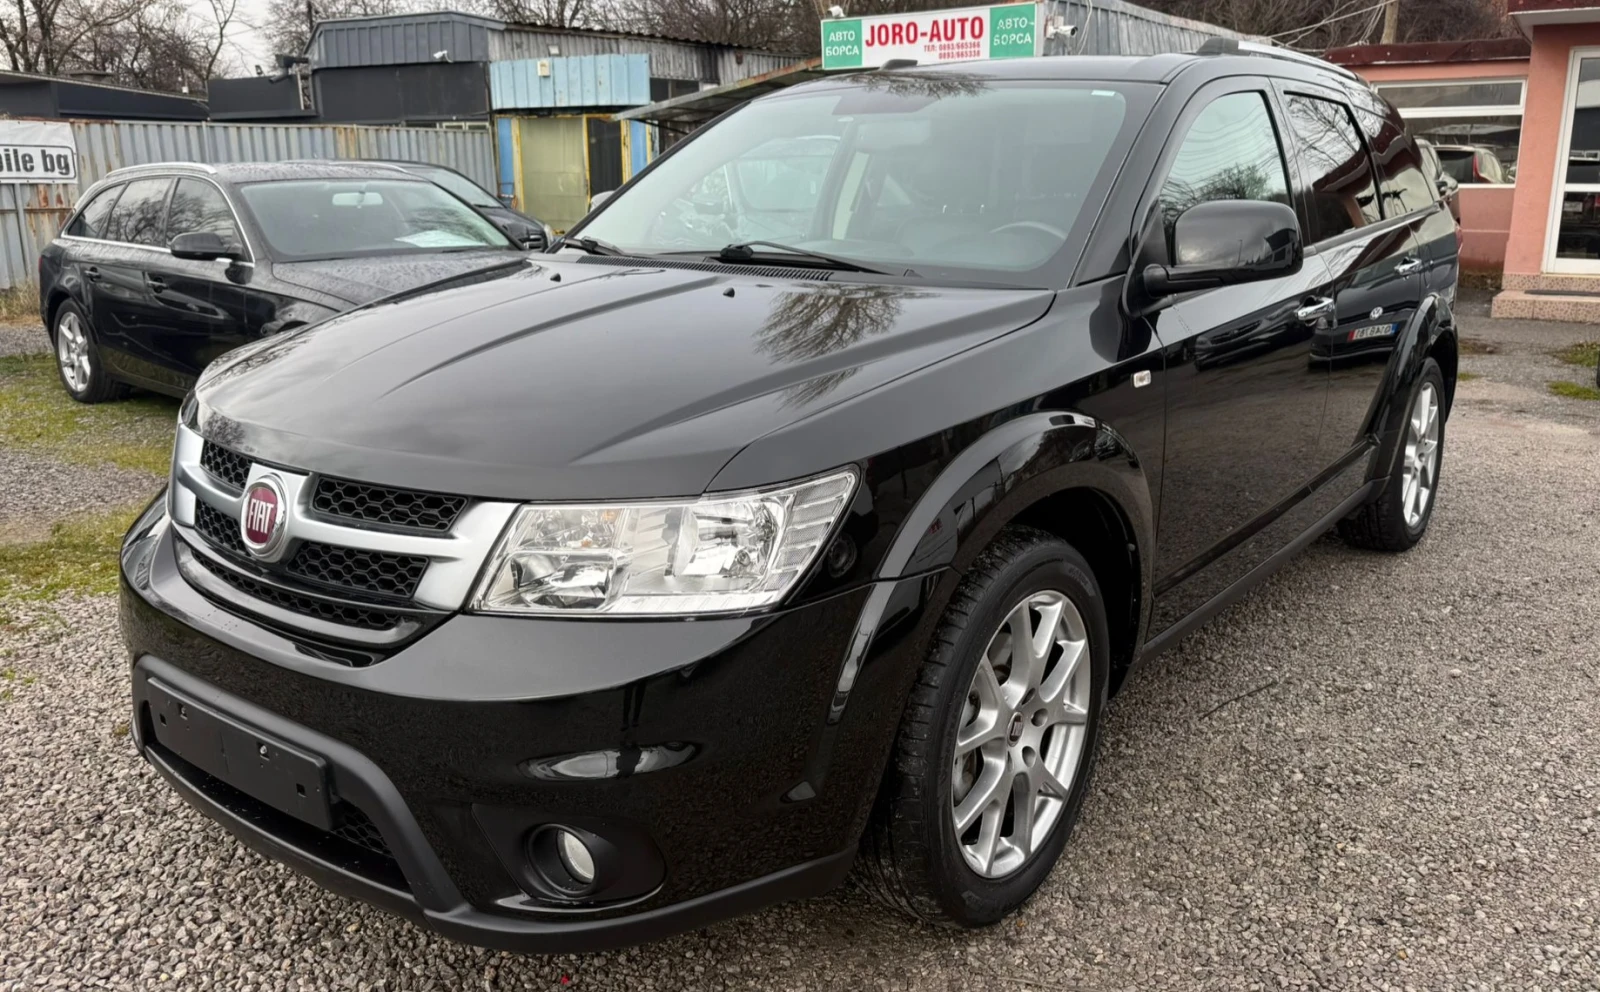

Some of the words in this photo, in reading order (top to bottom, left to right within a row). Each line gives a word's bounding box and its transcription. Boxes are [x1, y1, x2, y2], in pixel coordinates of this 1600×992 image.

[829, 30, 855, 42] АВТО
[865, 16, 984, 47] JORO-AUTO
[994, 33, 1032, 46] БОРСА
[825, 44, 859, 57] БОРСА
[0, 148, 35, 173] ile
[41, 149, 70, 175] bg
[247, 498, 275, 534] FIAT
